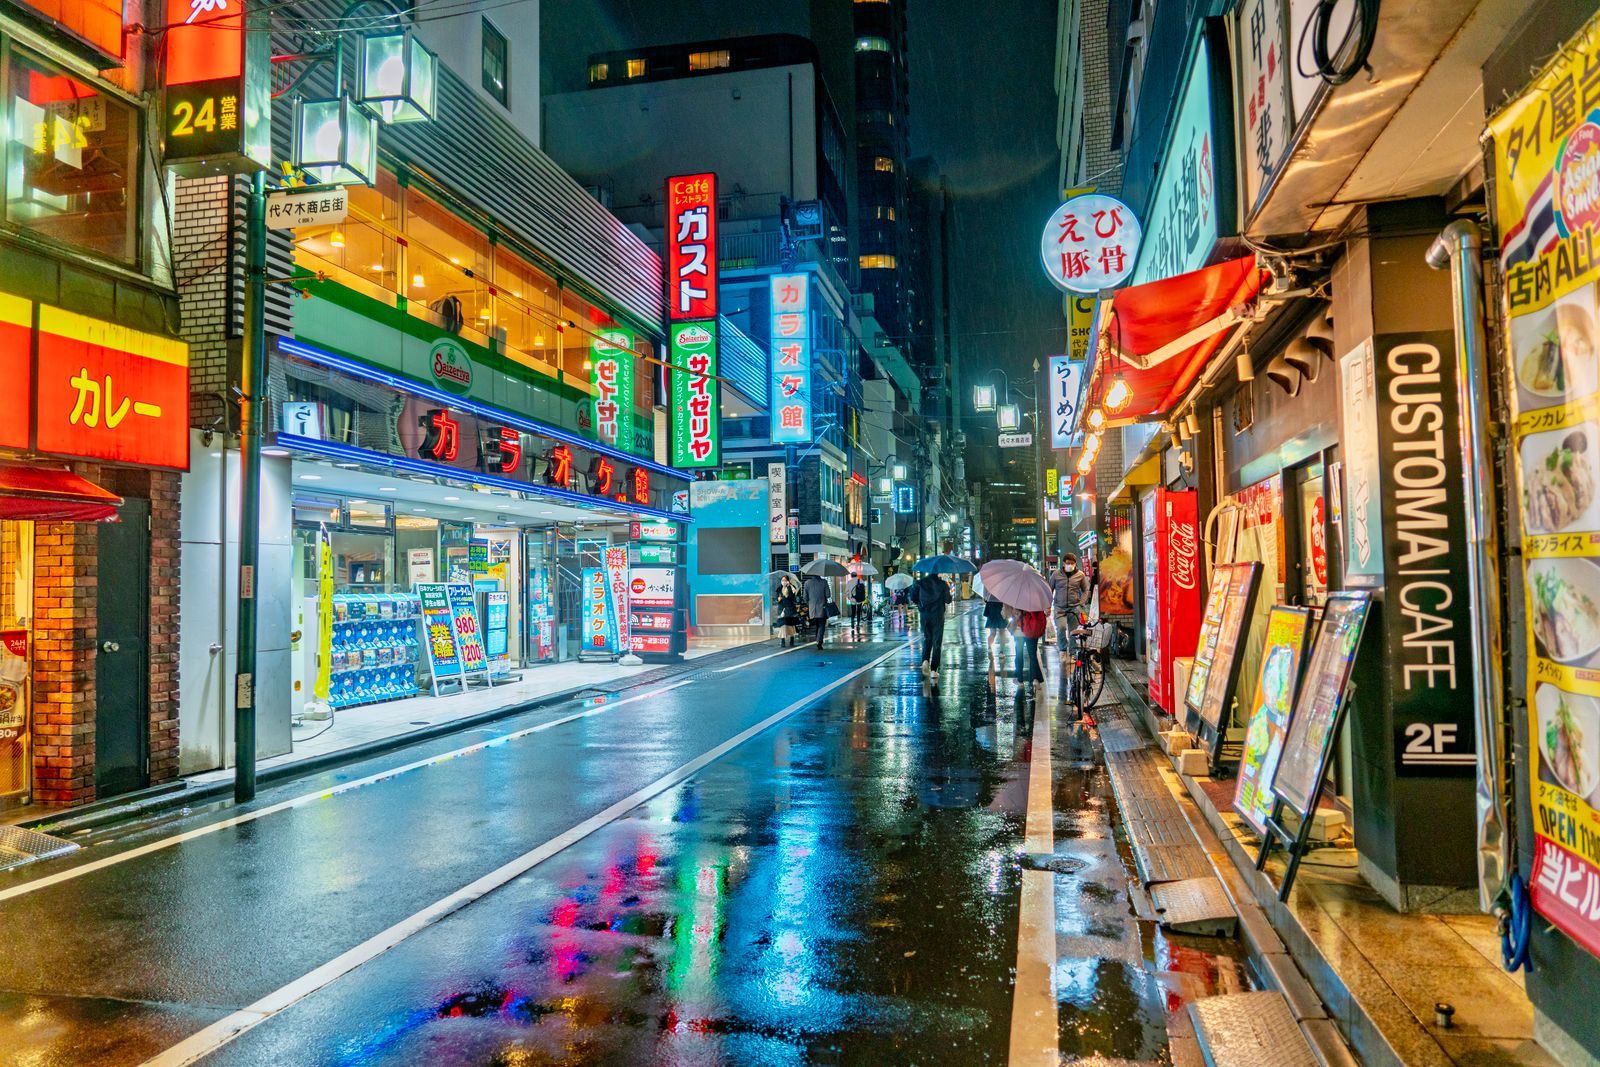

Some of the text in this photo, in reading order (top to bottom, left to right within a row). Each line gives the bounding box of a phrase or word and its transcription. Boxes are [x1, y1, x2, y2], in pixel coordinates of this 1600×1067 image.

[172, 95, 237, 136] 24 営業
[269, 197, 344, 218] 代々木商店街
[674, 179, 709, 195] Café
[675, 194, 709, 205] レストラン
[1058, 205, 1124, 244] えび
[677, 206, 708, 313] ガスト
[1061, 245, 1128, 280] 豚骨
[1509, 252, 1551, 309] 店内
[433, 352, 470, 383] Saizeriya
[779, 283, 804, 429] カラオケ館
[69, 366, 162, 429] カレー
[689, 354, 712, 460] サイゼリヤ
[1056, 361, 1075, 437] らーめん
[432, 408, 649, 505] カラオケ館
[771, 467, 782, 509] 喫煙室
[1387, 342, 1456, 690] CUSTOMA CAFE
[455, 616, 475, 634] 980
[593, 571, 605, 647] カラオケ館
[430, 623, 451, 641] 学生
[433, 641, 455, 658] 料金
[460, 644, 482, 662] 1200
[1405, 722, 1458, 753] 2F
[1539, 803, 1577, 849] OPEN
